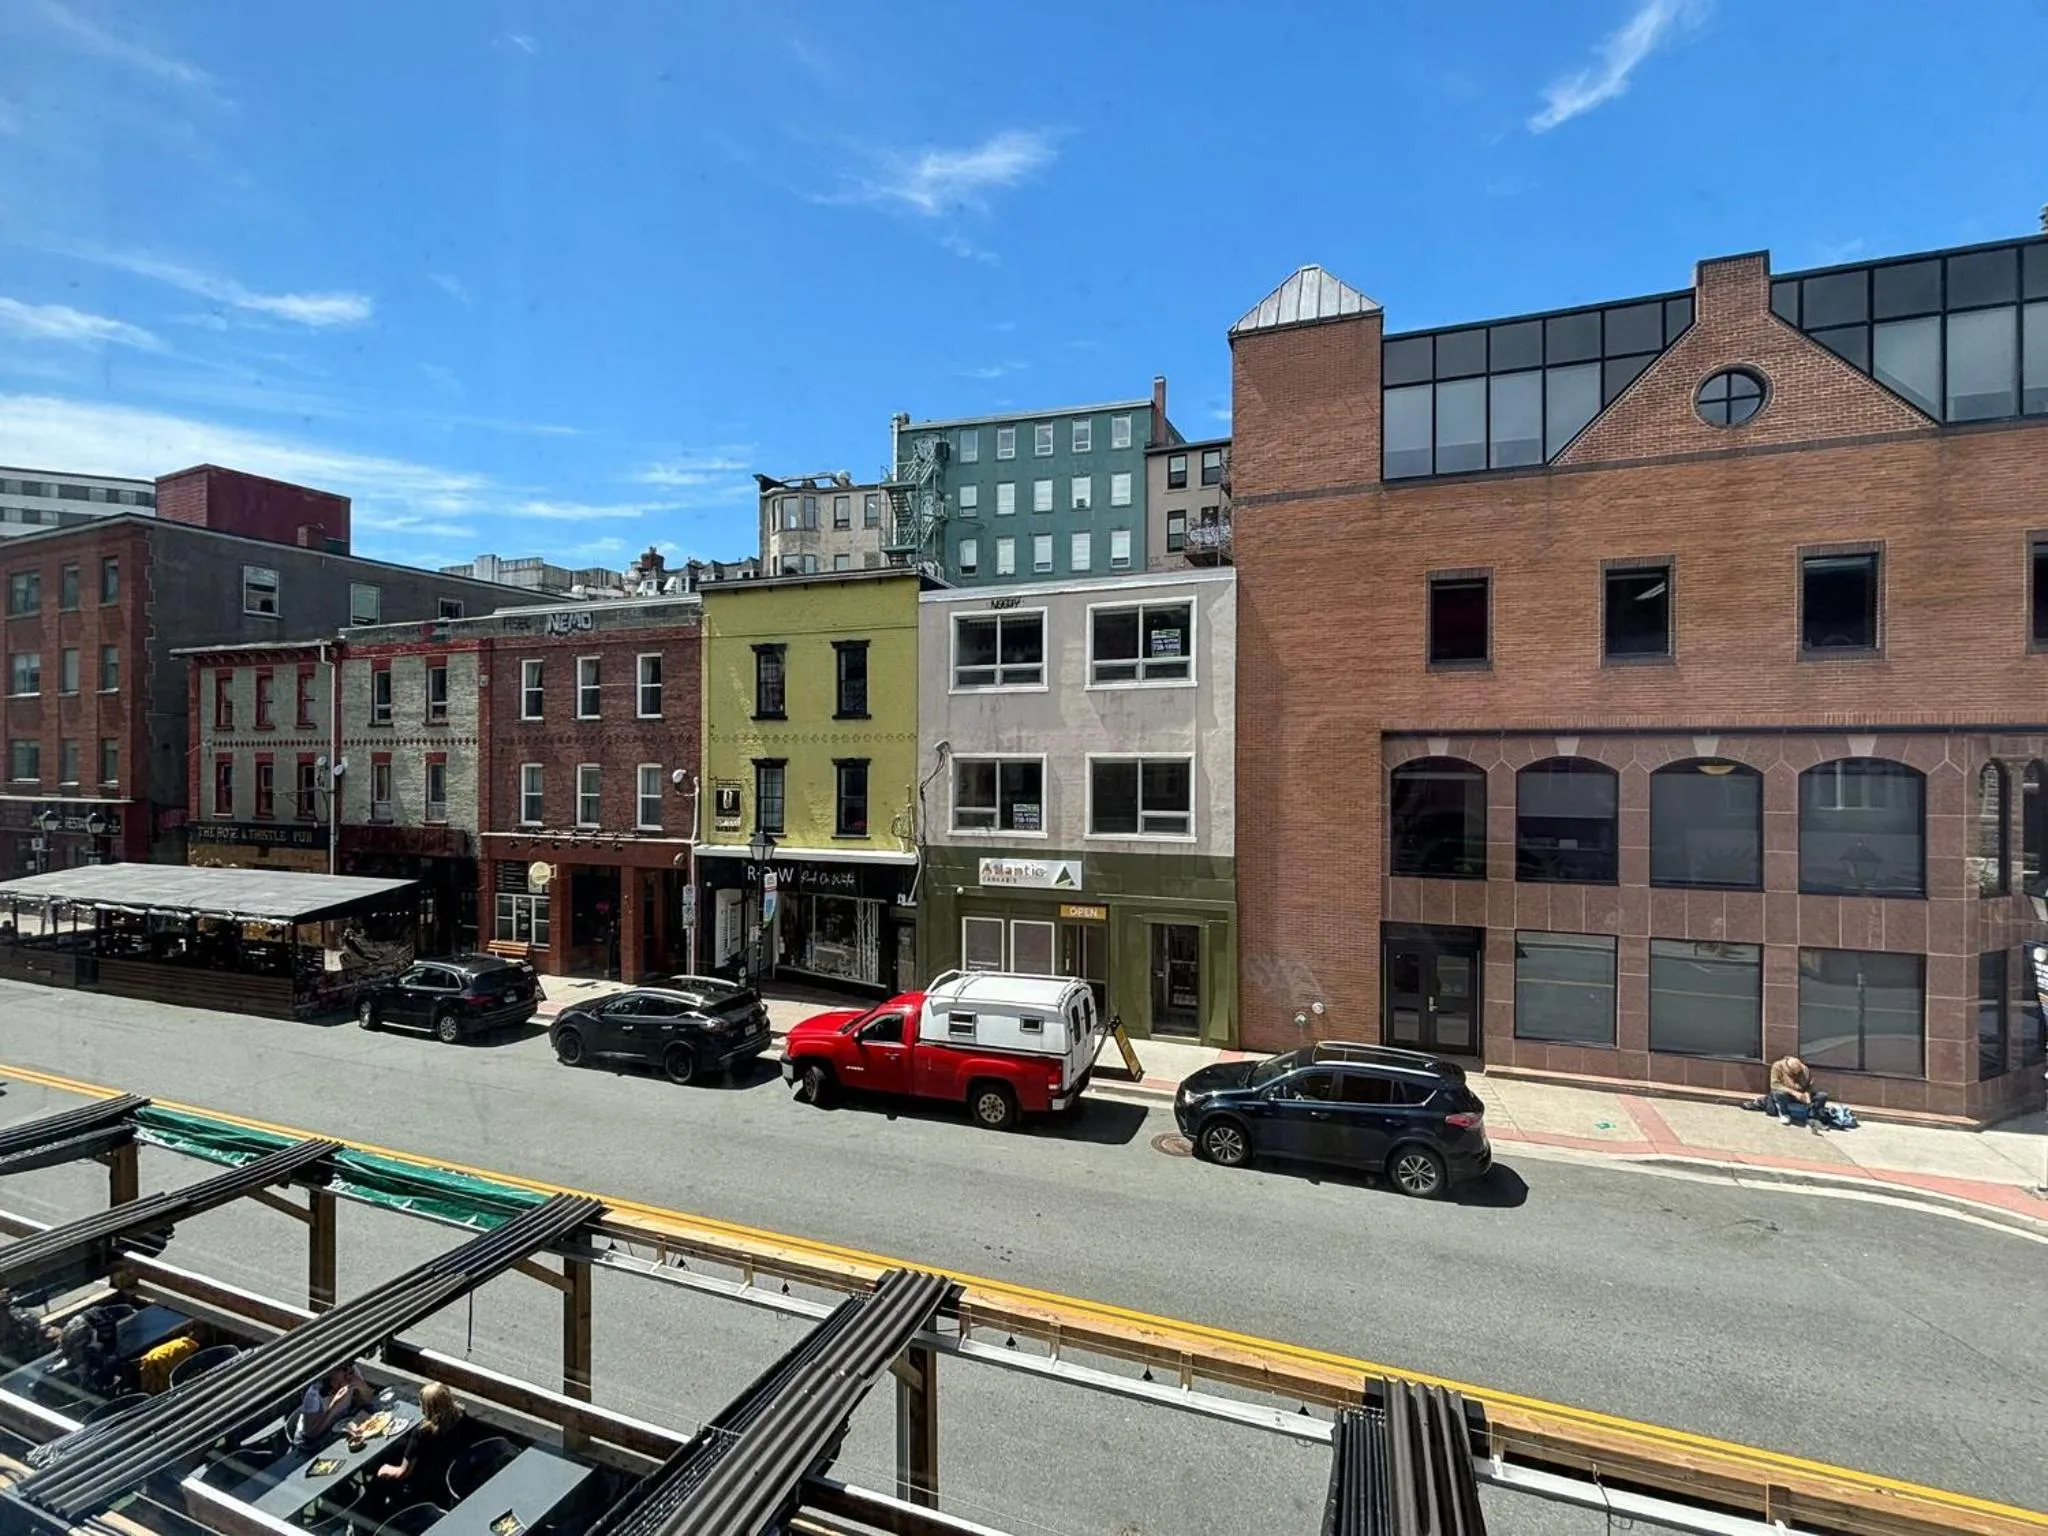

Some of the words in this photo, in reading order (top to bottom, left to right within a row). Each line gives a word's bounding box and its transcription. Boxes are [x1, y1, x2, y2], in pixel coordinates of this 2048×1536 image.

[548, 611, 594, 635] NEMO
[247, 829, 287, 842] THISTLE
[981, 862, 1046, 878] Atlantic
[1069, 906, 1099, 918] OPEN
